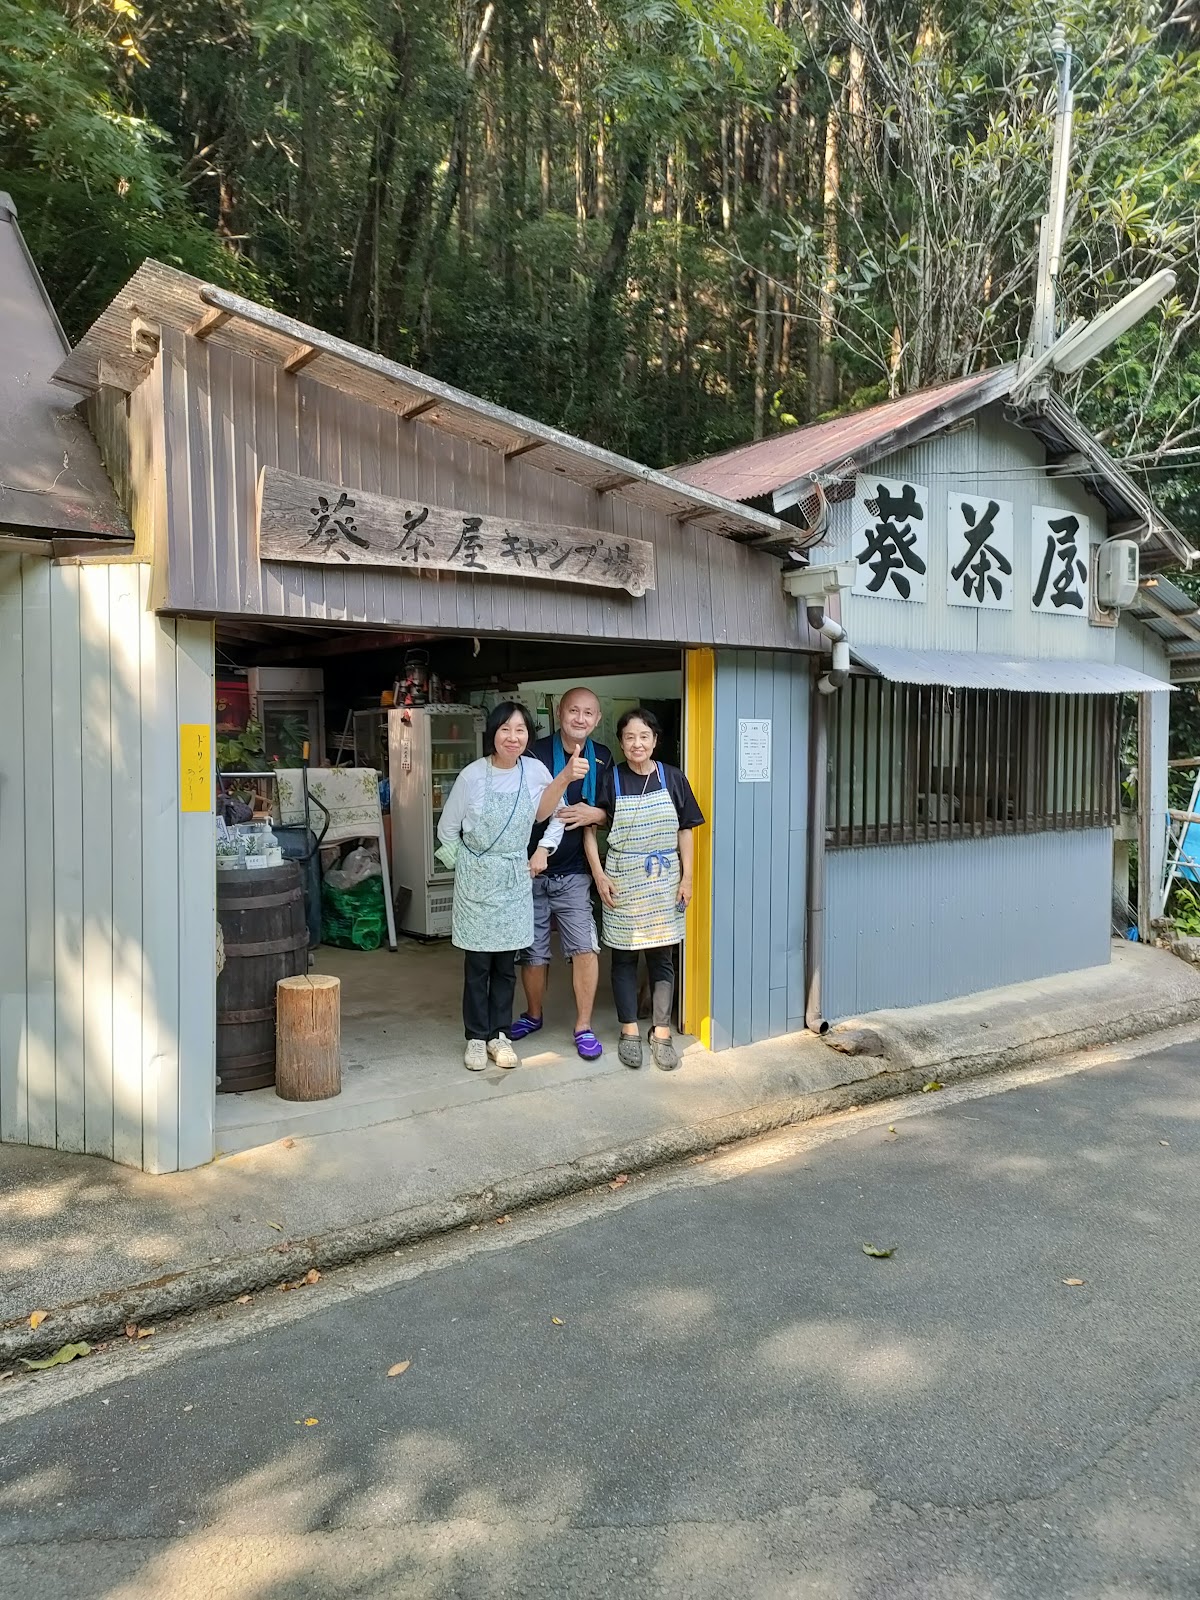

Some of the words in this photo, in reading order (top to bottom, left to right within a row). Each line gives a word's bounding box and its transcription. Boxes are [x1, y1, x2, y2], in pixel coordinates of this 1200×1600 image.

[855, 483, 1087, 609] 葵茶屋
[197, 734, 206, 785] ドリンク
